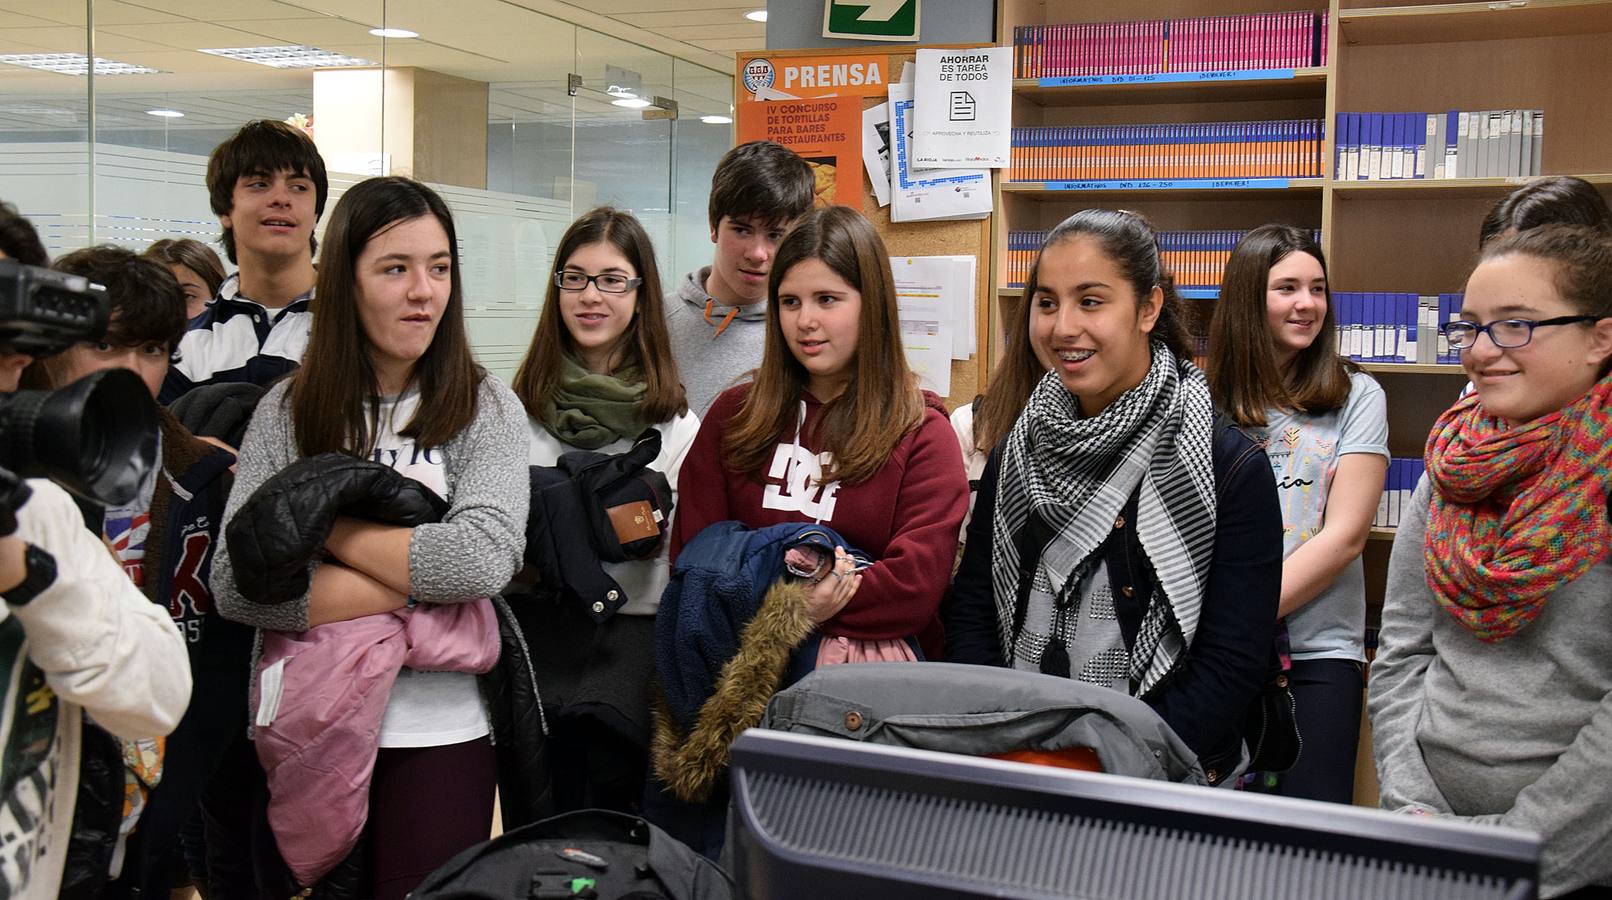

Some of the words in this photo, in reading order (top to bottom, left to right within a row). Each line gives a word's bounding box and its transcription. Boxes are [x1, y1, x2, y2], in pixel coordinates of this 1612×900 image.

[940, 55, 989, 64] AHORRAR
[941, 64, 954, 73] ES
[957, 64, 987, 72] TAREA
[784, 63, 882, 88] PRENSA
[940, 73, 953, 81] DE
[955, 72, 989, 81] TODOS
[767, 105, 777, 115] IV
[780, 102, 837, 114] CONCURSO
[767, 115, 780, 125] DE
[782, 113, 830, 124] TORTILLAS
[767, 125, 793, 135] PARA
[796, 124, 826, 134] BARES
[777, 133, 846, 145] RESTAURANTES
